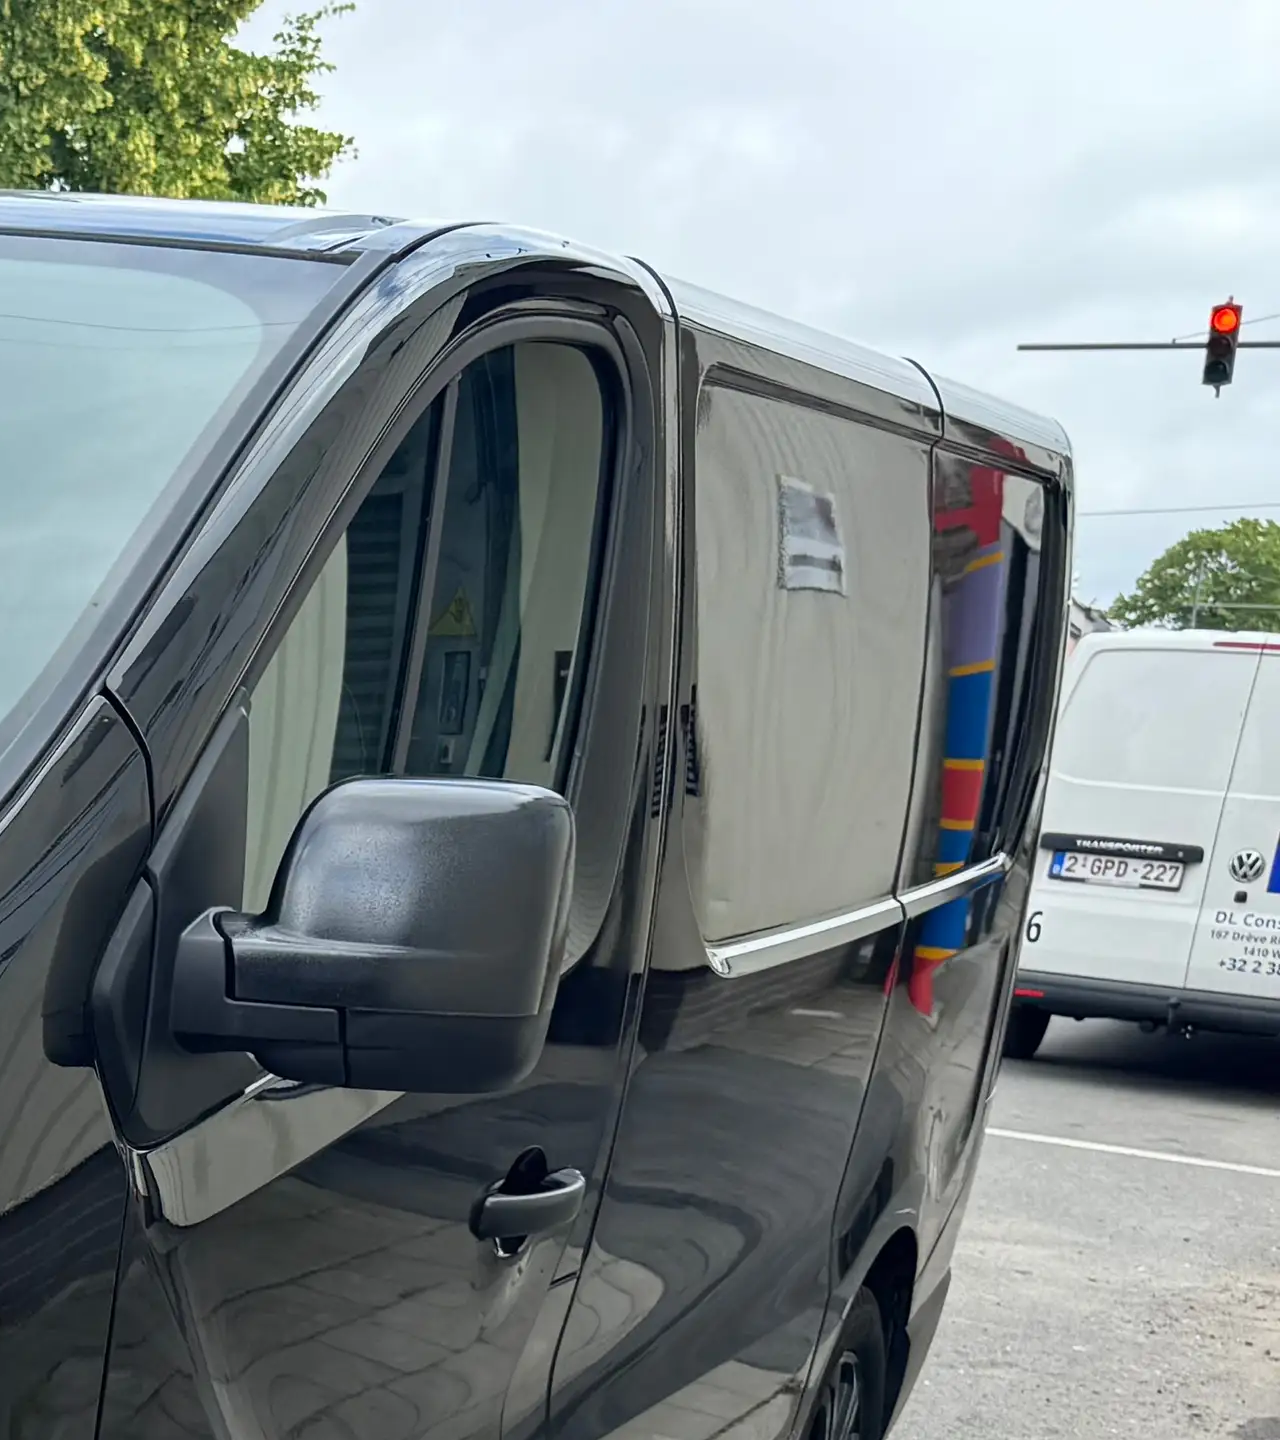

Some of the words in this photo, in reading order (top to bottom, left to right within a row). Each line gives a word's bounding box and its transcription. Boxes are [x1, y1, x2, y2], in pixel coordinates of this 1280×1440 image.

[1075, 839, 1164, 855] TRANSPORTER
[1215, 911, 1237, 925] DL
[1026, 911, 1044, 943] 6
[1243, 946, 1269, 958] 1410
[1218, 957, 1247, 973] +32
[1252, 960, 1262, 974] 2
